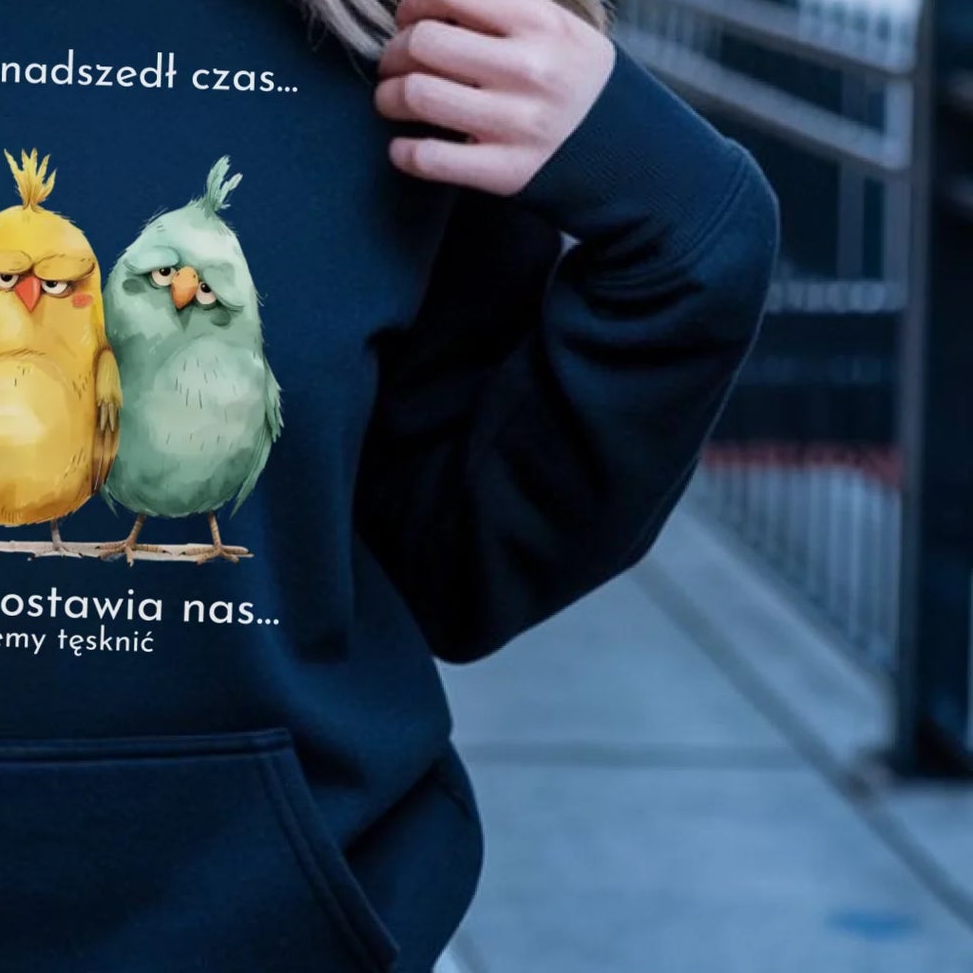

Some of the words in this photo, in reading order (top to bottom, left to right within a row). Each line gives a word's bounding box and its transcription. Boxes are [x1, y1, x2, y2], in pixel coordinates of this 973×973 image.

[1, 48, 178, 89] nadszedł
[192, 68, 299, 93] czas...
[183, 600, 280, 625] nas...
[57, 624, 154, 657] tęsknić
